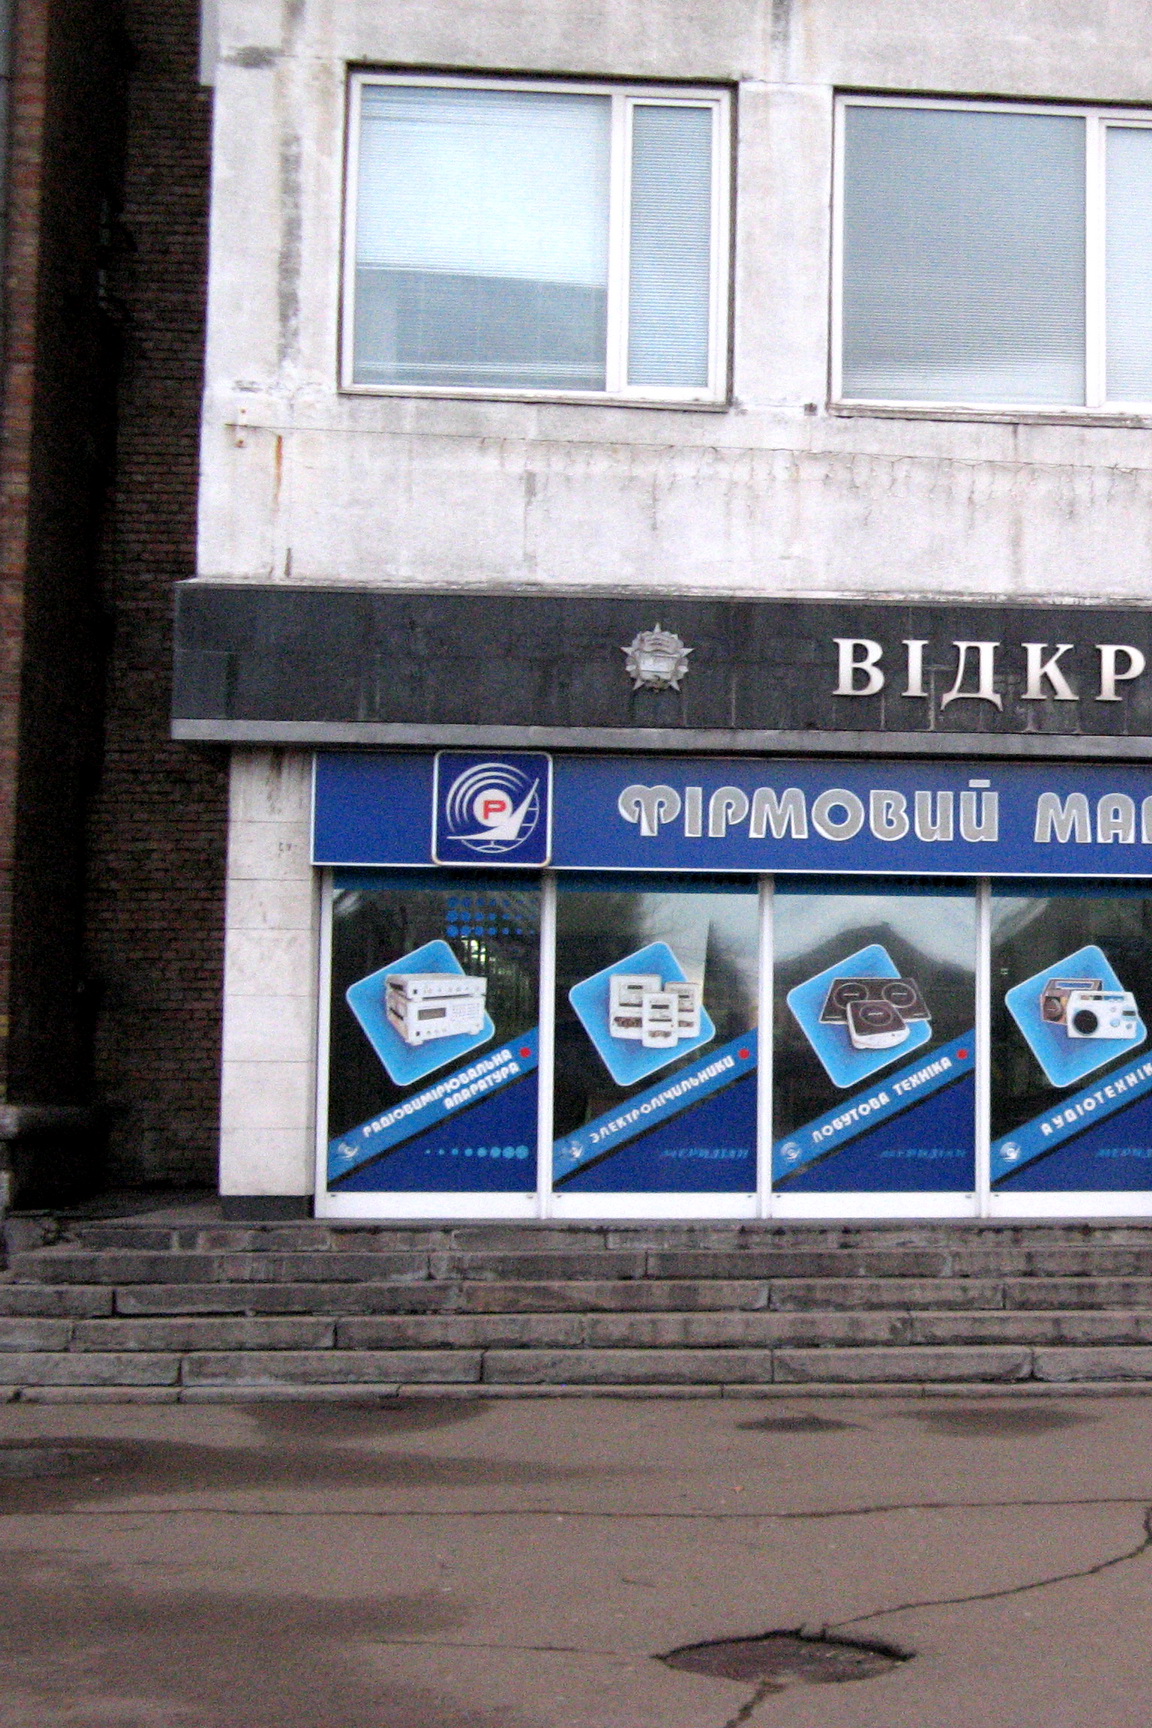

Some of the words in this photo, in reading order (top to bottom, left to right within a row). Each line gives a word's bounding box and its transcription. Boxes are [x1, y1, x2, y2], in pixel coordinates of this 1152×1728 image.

[618, 779, 999, 843] ФІРМОВИЙ
[362, 1048, 513, 1138] РАДІОВИМІРЮВАЛЬНА
[443, 1061, 521, 1109] АПАРАТУРА
[811, 1092, 891, 1143] ПОБУТОВА
[892, 1056, 953, 1096] ТЕХНІКА
